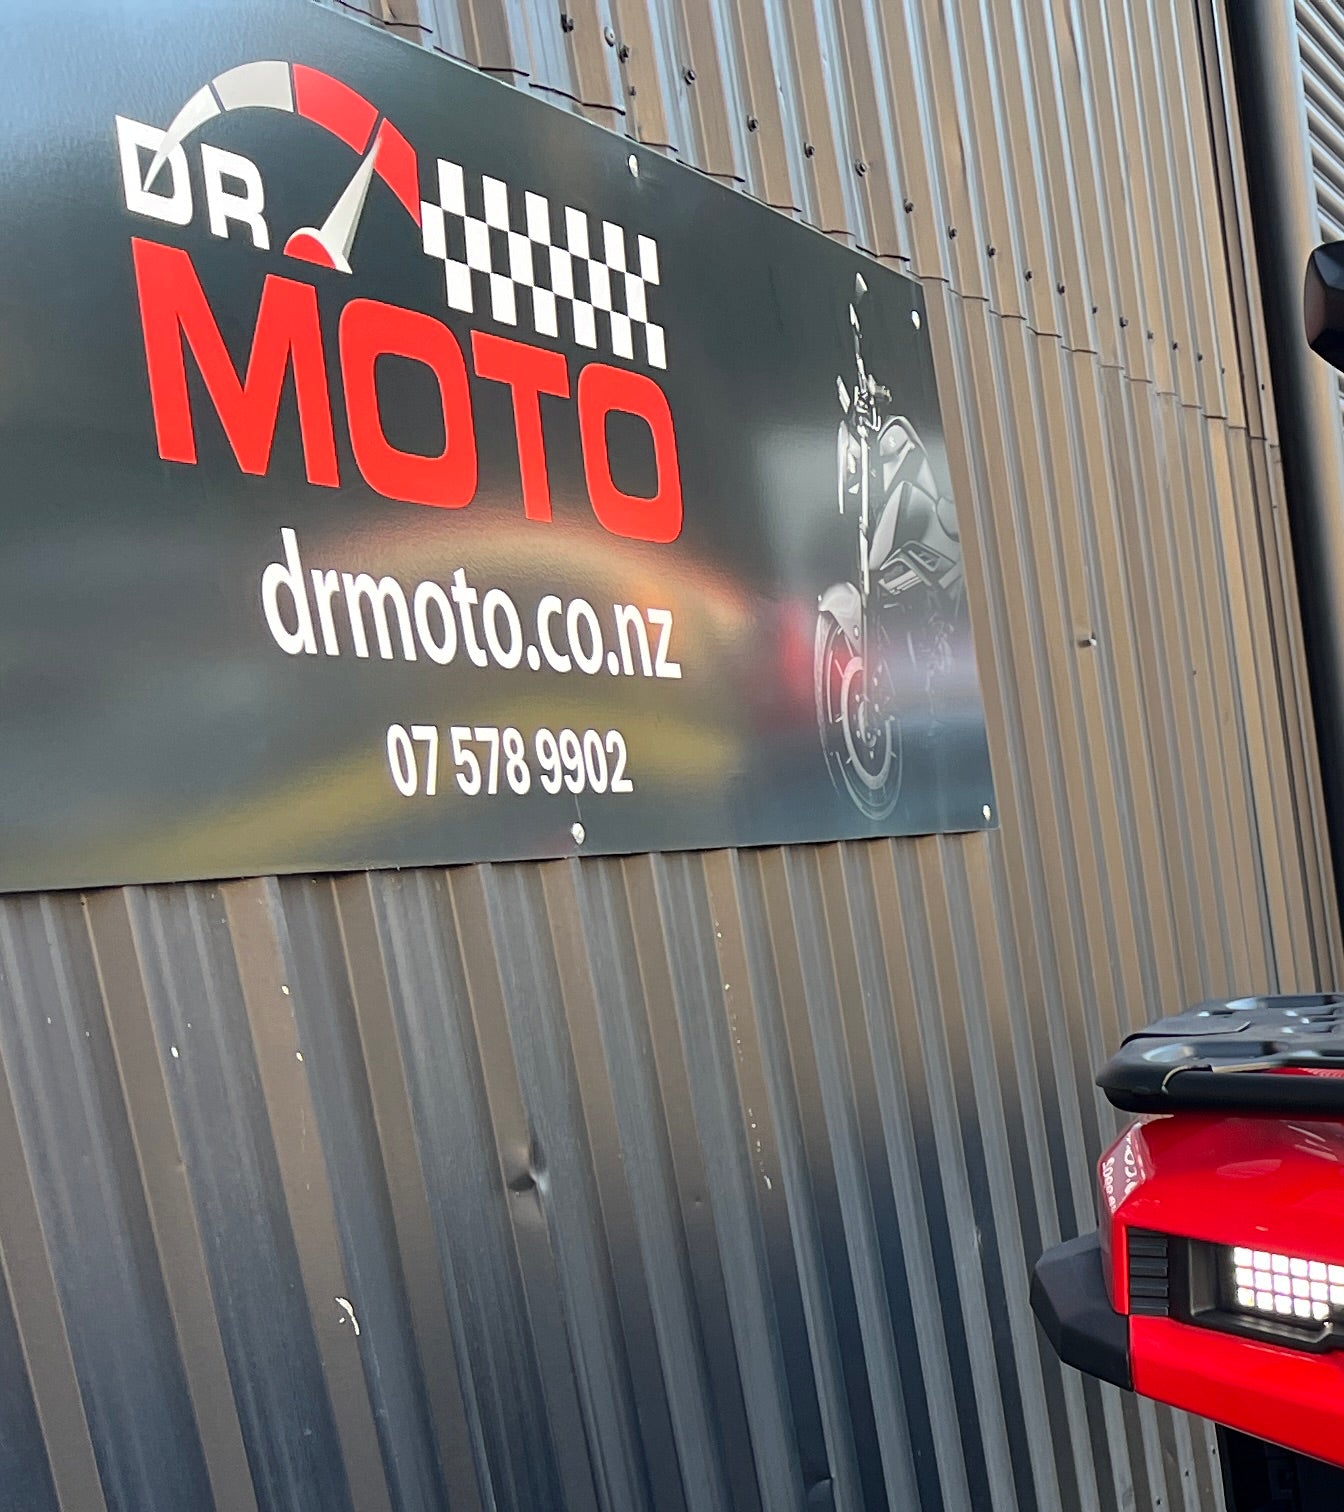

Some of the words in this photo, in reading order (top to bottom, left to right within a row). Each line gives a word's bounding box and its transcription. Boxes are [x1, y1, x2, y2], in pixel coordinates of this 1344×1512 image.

[115, 115, 270, 250] DR
[131, 237, 684, 543] MOTO
[261, 528, 683, 679] drmoto.co.nz
[386, 724, 438, 796] 07
[454, 727, 529, 794] 578
[539, 730, 634, 794] 9902
